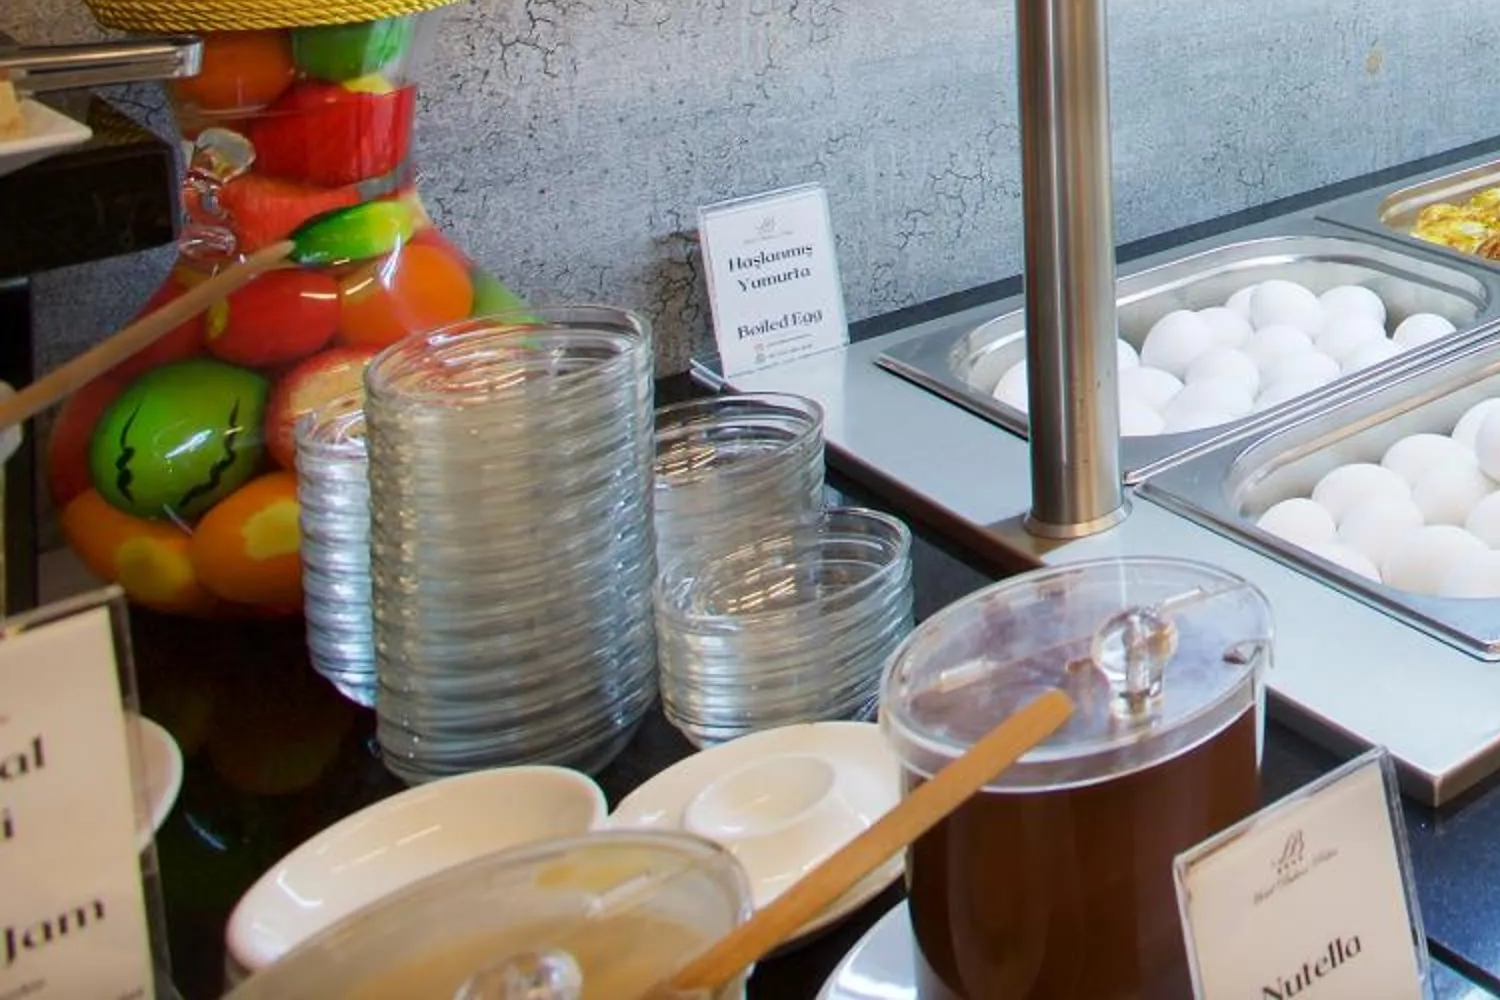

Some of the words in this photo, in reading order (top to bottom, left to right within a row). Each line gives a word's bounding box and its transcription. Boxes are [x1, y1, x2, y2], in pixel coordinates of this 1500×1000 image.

[728, 245, 813, 272] Haşlanmış
[737, 267, 812, 292] Yumurta
[737, 312, 788, 340] Boiled
[791, 309, 823, 327] Egg
[2, 898, 105, 968] Jam
[1262, 935, 1361, 1000] Nutella
